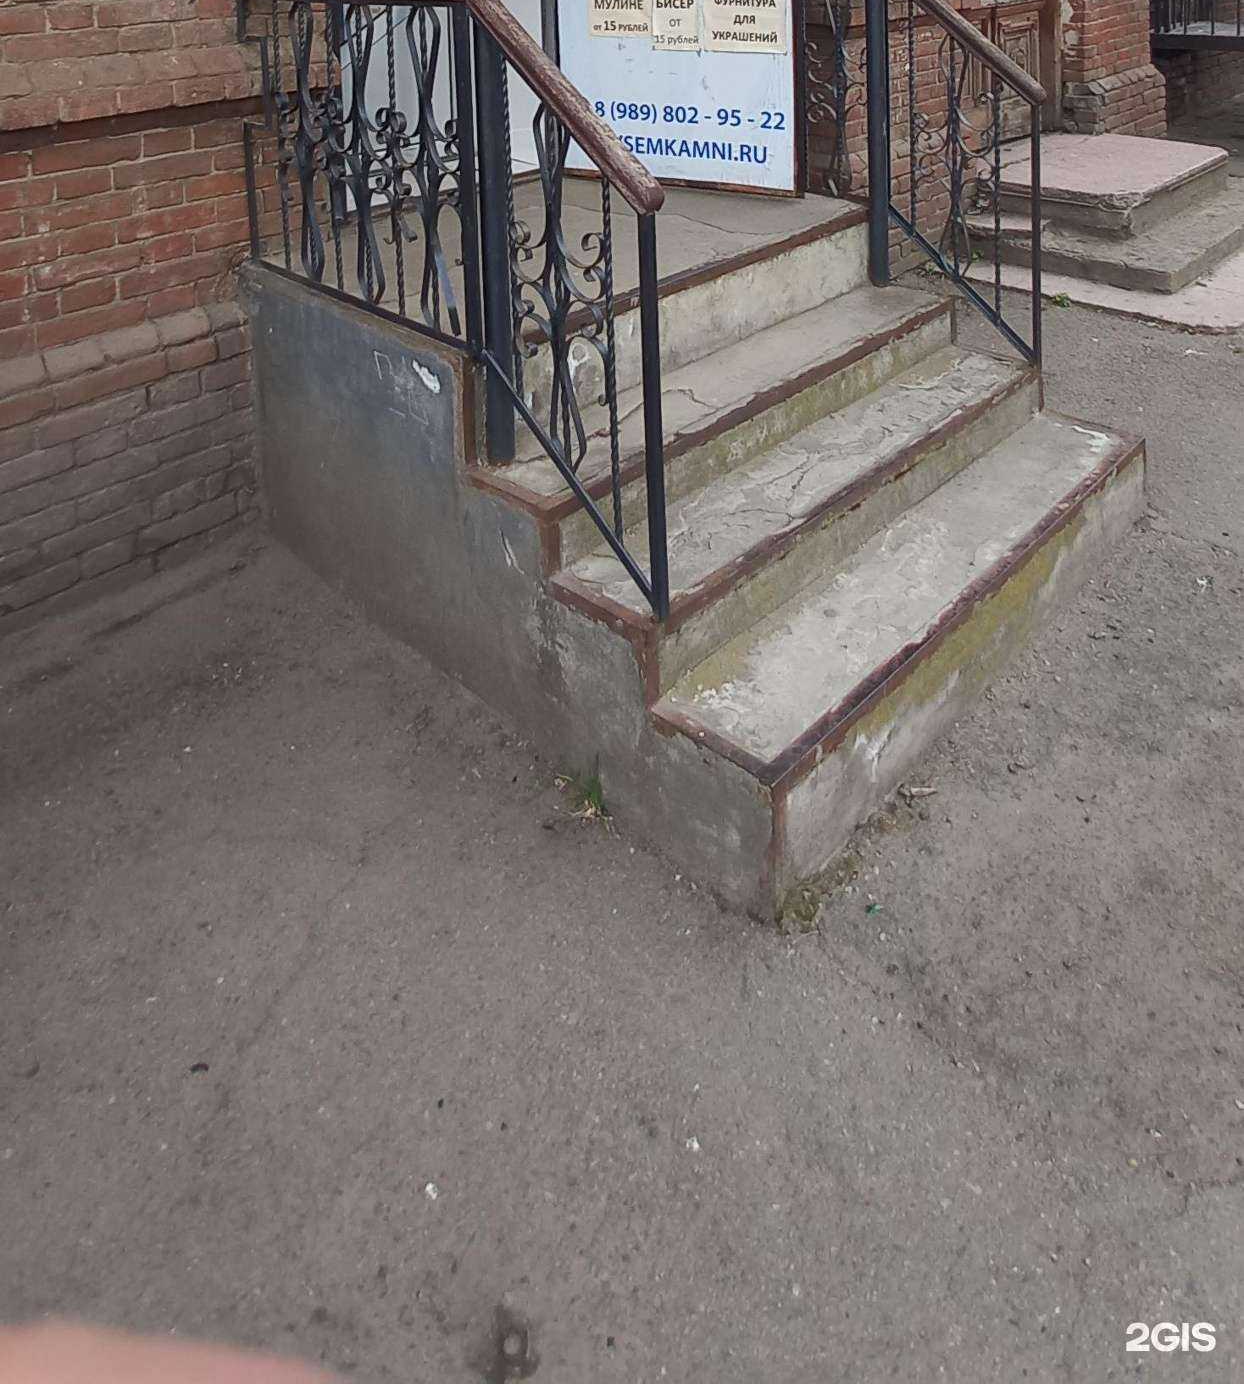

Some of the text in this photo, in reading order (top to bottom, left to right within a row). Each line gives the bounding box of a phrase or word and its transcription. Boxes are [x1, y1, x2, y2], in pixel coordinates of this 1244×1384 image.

[603, 20, 617, 32] 15
[733, 14, 756, 25] ДЛЯ
[655, 34, 699, 46] 15 рублей
[711, 30, 778, 44] УКРАШЕНИЙ
[594, 101, 606, 118] 8
[610, 101, 657, 124] (989)
[662, 105, 699, 124] 802
[716, 108, 742, 127] 95
[760, 111, 786, 130] 22
[619, 135, 768, 164] SEMKAMNI.RU
